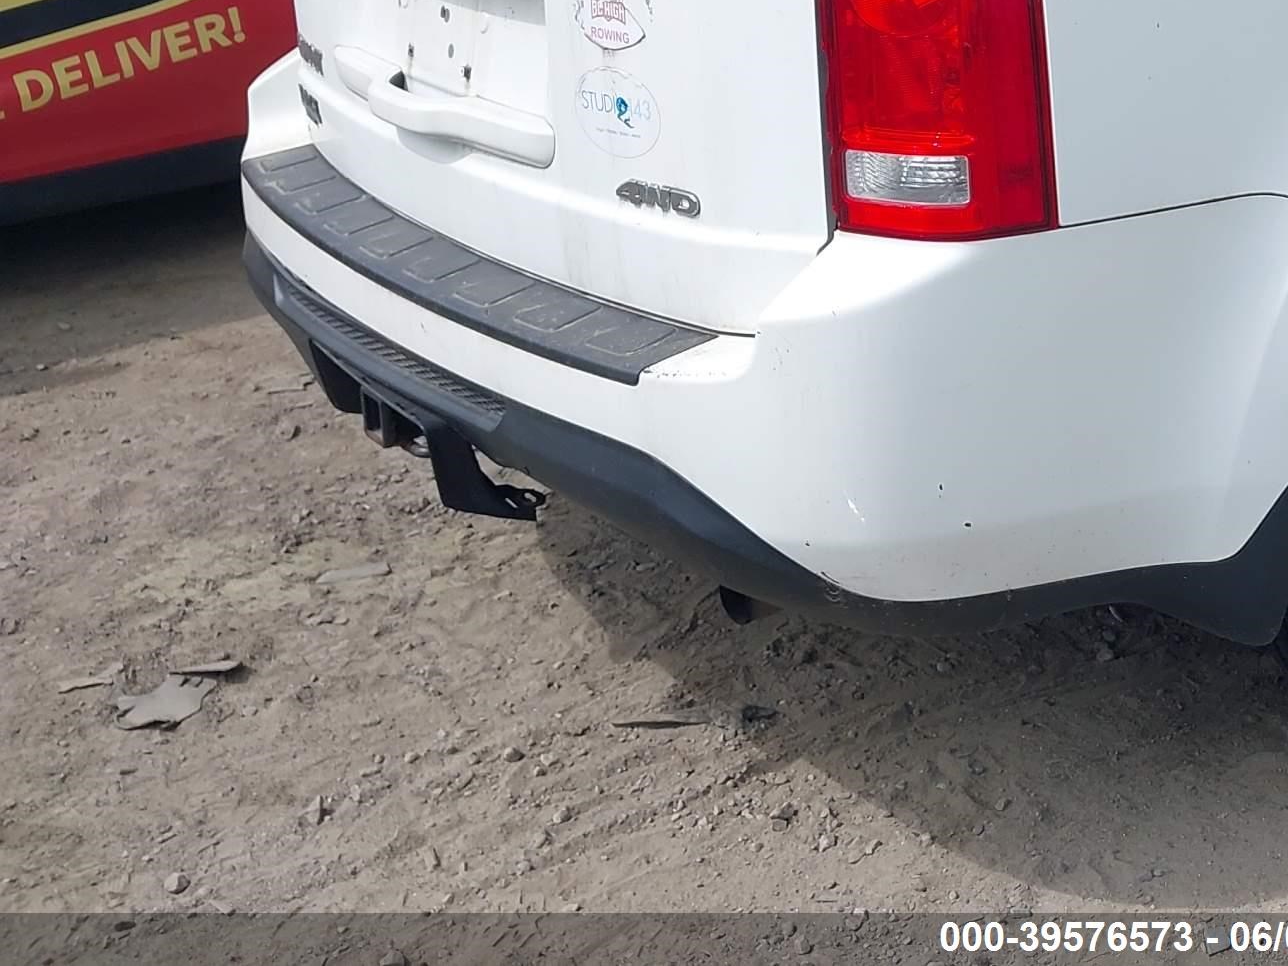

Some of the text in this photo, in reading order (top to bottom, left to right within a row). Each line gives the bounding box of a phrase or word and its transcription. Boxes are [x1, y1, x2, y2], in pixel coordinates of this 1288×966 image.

[590, 26, 630, 44] ROWING
[13, 6, 246, 112] DELIVER!
[616, 178, 701, 218] 4WD
